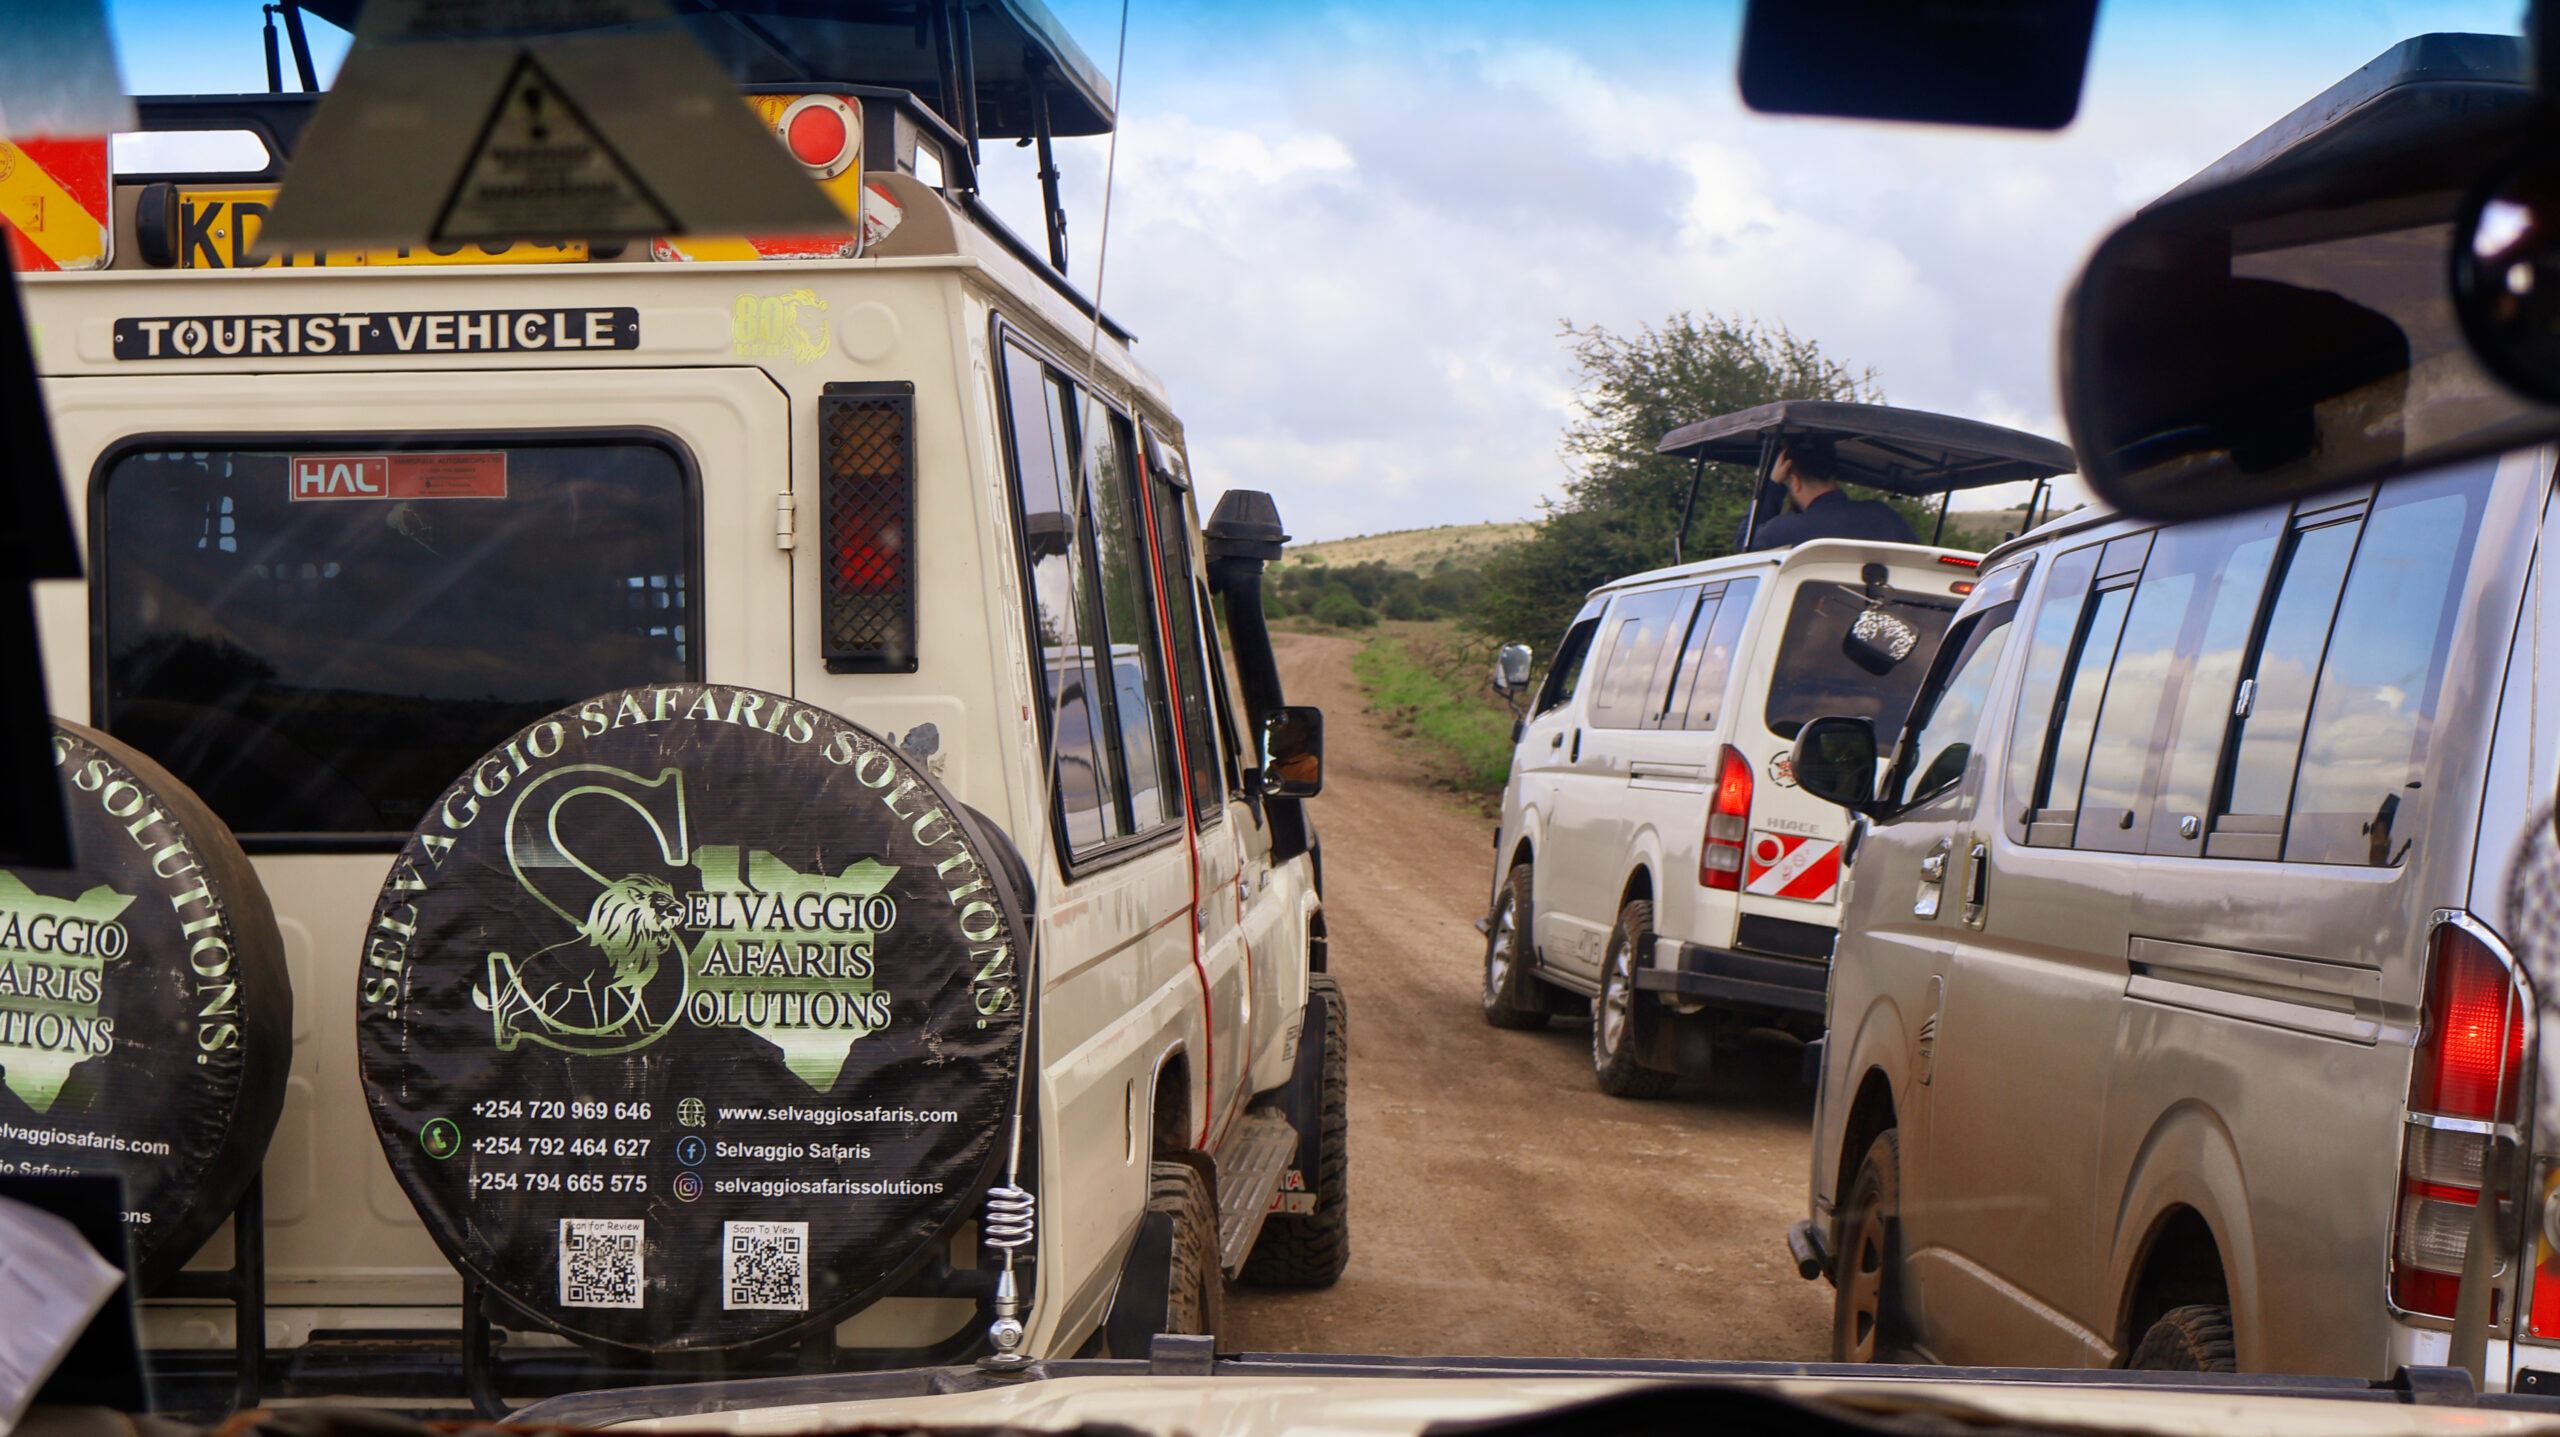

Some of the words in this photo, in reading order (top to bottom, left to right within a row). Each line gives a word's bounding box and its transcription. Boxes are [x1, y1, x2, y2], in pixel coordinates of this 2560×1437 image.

[178, 202, 327, 269] KD
[138, 316, 370, 357] TOURIST
[388, 312, 615, 351] VEHICLE
[300, 463, 379, 494] HAL
[579, 688, 821, 744] SAFARIS
[686, 891, 897, 934] ELVAGGIO
[0, 910, 129, 961] AGGIO
[698, 939, 875, 980] AFARIS
[687, 989, 893, 1031] OLUTIONS
[472, 1100, 523, 1119] +254
[528, 1101, 565, 1119] 720
[571, 1101, 608, 1120] 969
[614, 1102, 651, 1120] 646
[718, 1106, 958, 1126] www.selvaggiosafaris.com
[0, 1123, 170, 1156] lvaggiosafaris.com
[472, 1136, 522, 1155] +254
[528, 1137, 565, 1156] 792
[570, 1138, 608, 1156] 464
[614, 1138, 651, 1157] 627
[715, 1141, 804, 1162] Selvaggio
[808, 1142, 872, 1160] Safaris
[468, 1172, 519, 1191] +254
[524, 1173, 561, 1192] 794
[567, 1174, 604, 1192] 665
[610, 1174, 647, 1193] 575
[714, 1177, 944, 1197] selvaggiosafarissolutions
[589, 1221, 605, 1231] for
[607, 1221, 640, 1232] Review
[733, 1224, 756, 1234] Scan
[758, 1224, 771, 1234] To
[773, 1224, 796, 1235] View
